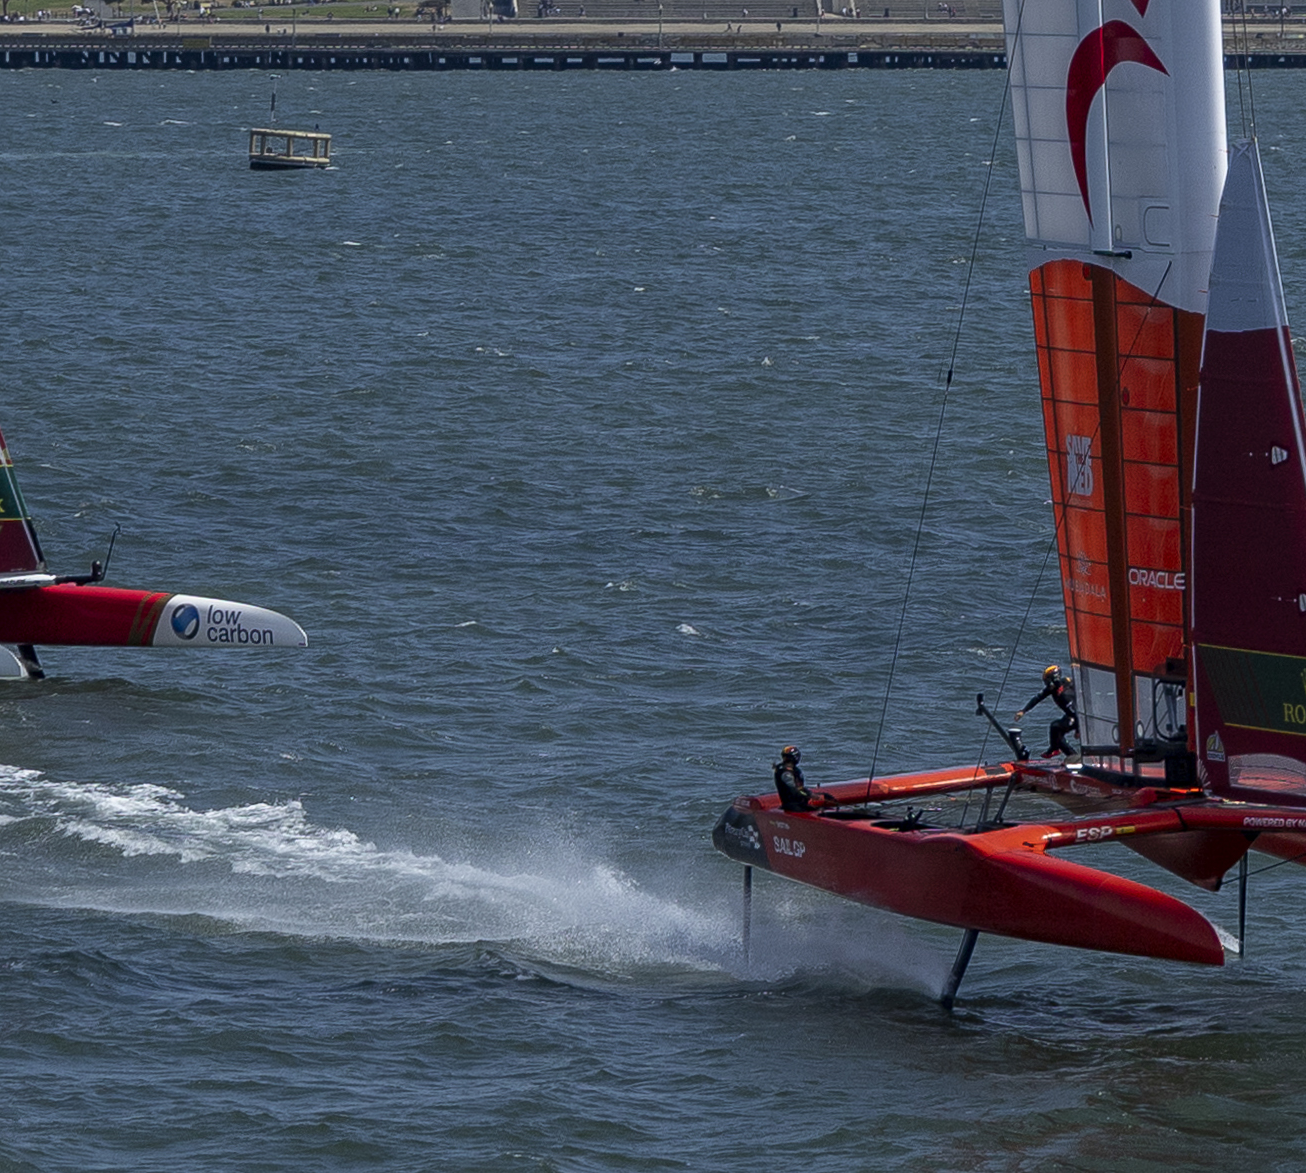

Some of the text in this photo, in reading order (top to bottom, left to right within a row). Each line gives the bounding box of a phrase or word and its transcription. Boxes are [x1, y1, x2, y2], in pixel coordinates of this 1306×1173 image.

[1128, 568, 1187, 590] ORACLE
[206, 604, 242, 625] low
[206, 624, 274, 645] carbon
[1076, 825, 1113, 843] ESP
